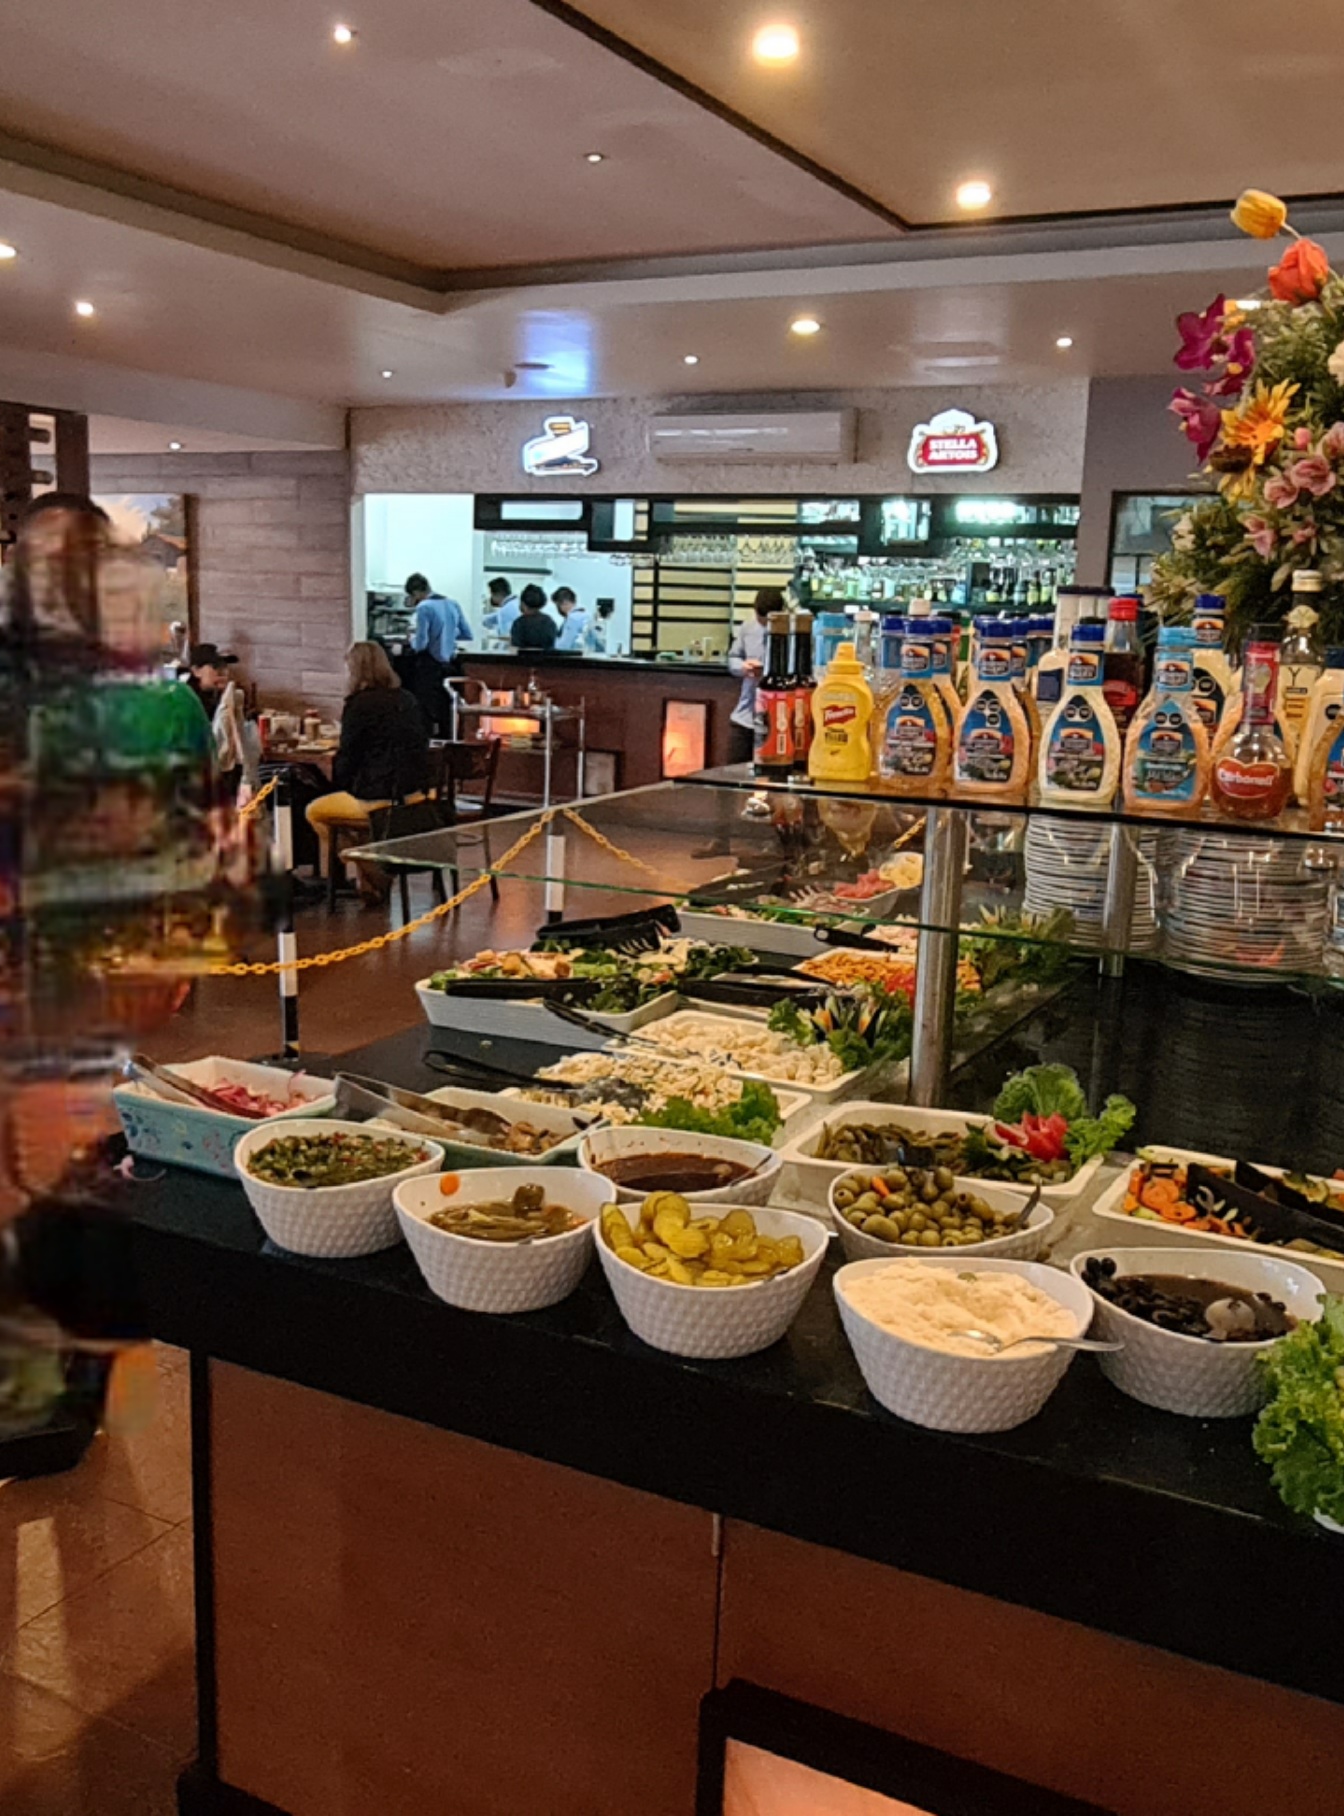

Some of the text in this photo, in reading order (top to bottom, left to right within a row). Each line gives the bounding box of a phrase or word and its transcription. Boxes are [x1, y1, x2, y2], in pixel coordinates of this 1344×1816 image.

[929, 438, 978, 450] STELLA
[928, 449, 979, 461] ARTOIS
[1217, 768, 1274, 786] Carbonell
